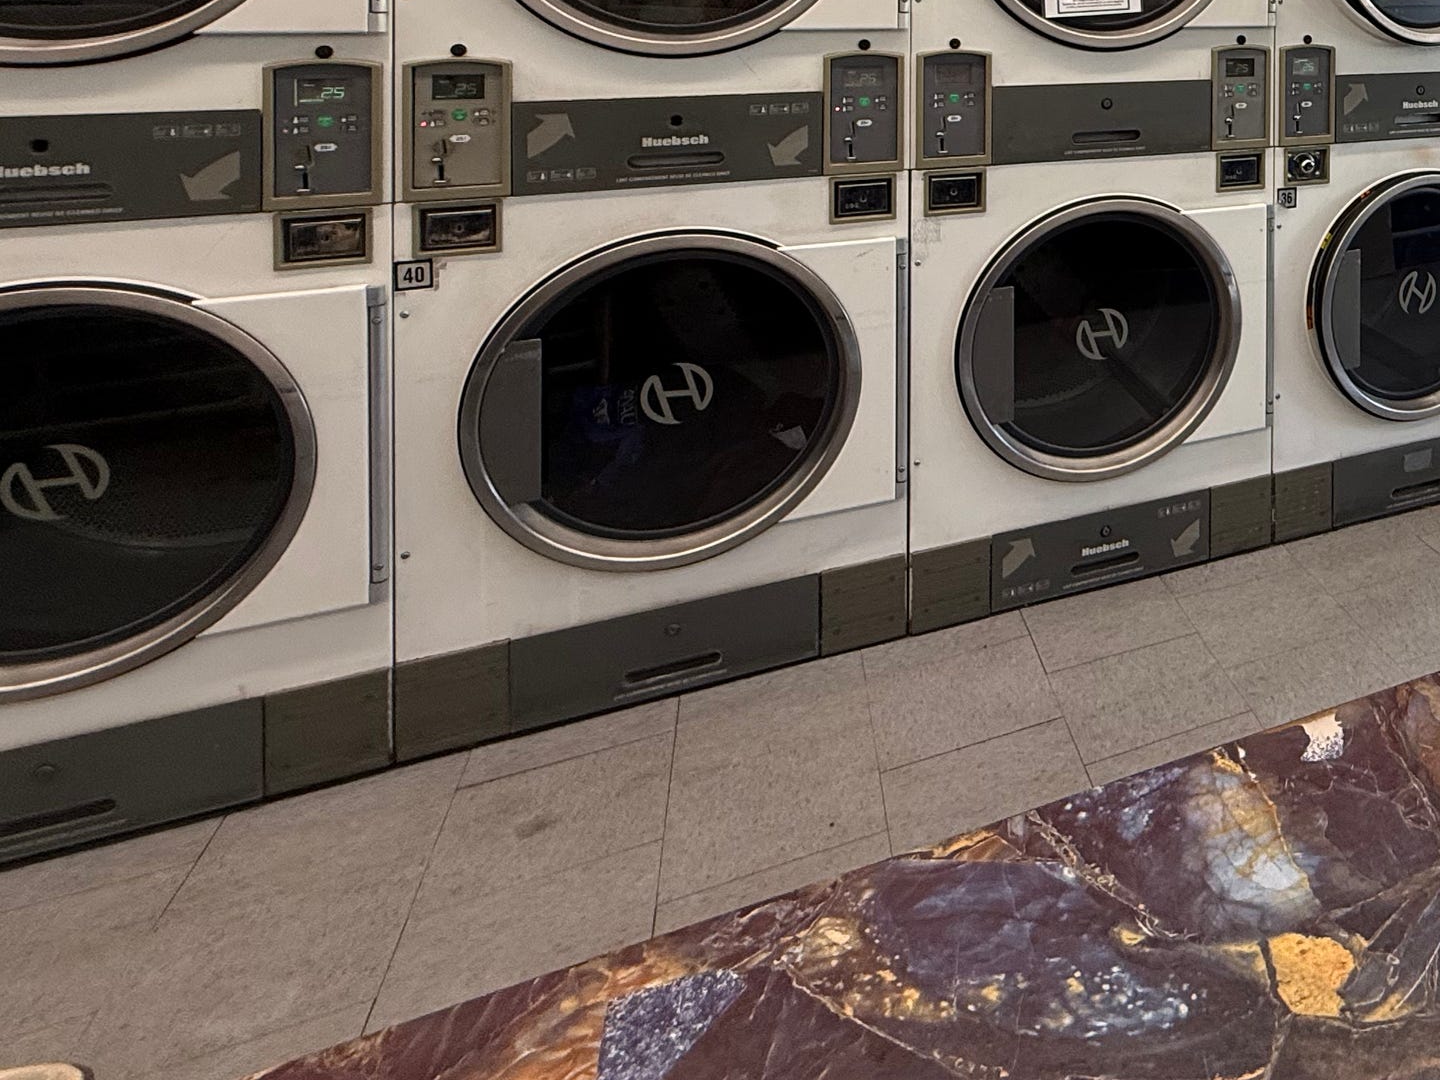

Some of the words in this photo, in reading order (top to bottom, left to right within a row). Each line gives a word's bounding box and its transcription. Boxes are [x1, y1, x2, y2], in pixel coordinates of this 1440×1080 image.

[321, 86, 345, 99] 25
[454, 82, 477, 96] 25
[1402, 99, 1439, 110] Huebsch
[641, 134, 710, 148] Huebsch
[0, 162, 91, 179] uebsch
[1281, 191, 1293, 204] 36
[403, 267, 425, 284] 40
[1081, 539, 1130, 557] Huebsch
